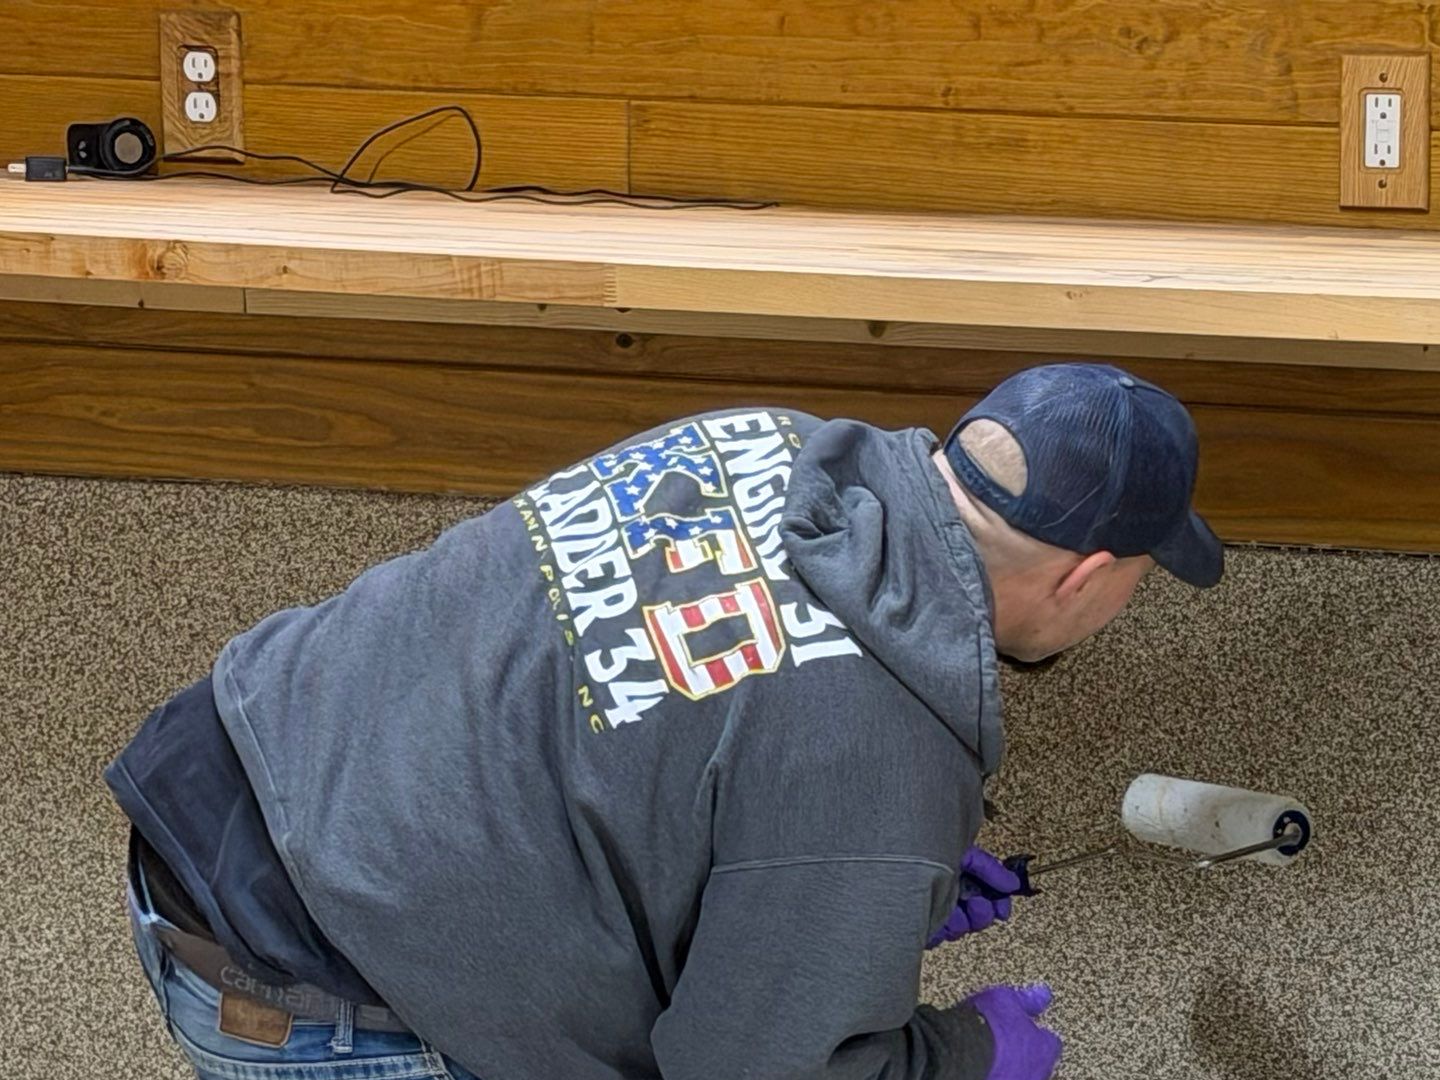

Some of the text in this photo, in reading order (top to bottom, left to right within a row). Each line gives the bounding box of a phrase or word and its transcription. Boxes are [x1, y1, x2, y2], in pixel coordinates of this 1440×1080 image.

[526, 465, 670, 729] LADDER 34
[588, 421, 786, 701] KFD
[780, 601, 863, 668] 31
